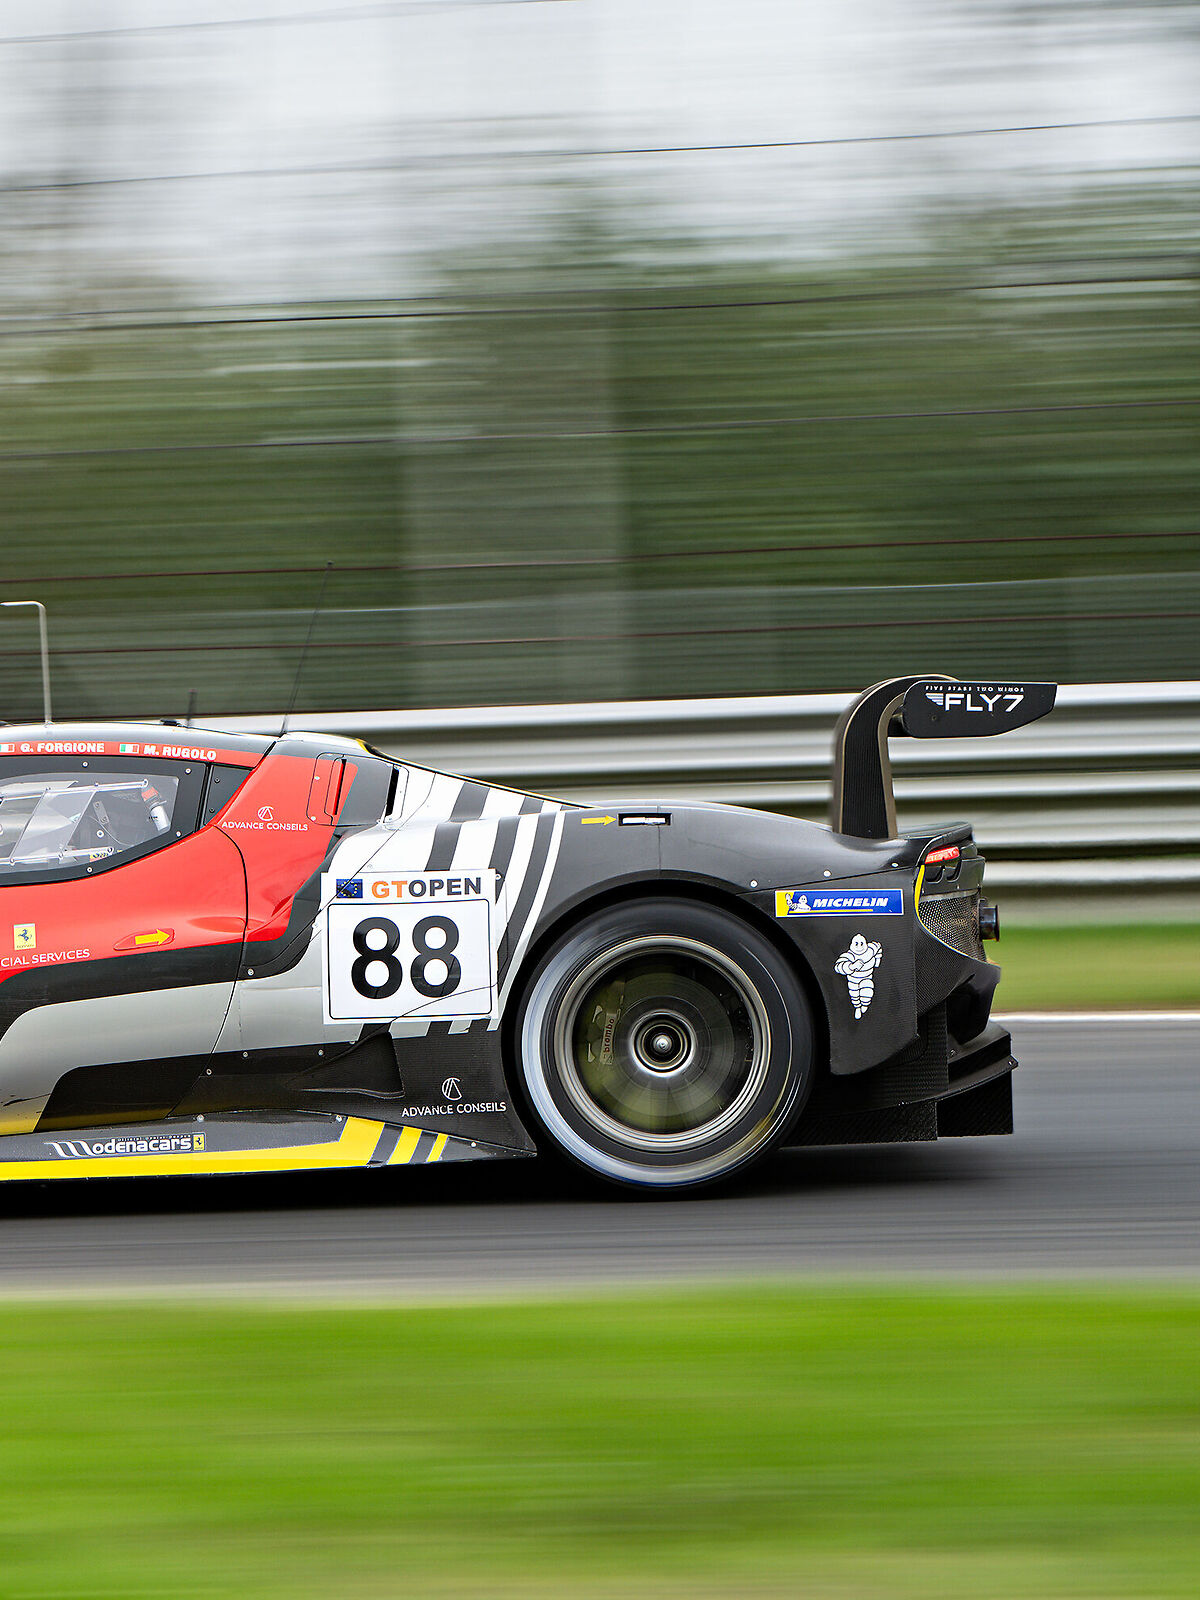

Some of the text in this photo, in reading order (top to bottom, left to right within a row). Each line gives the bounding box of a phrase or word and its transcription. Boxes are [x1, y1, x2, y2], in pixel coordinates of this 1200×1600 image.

[945, 693, 1024, 712] FLY7
[20, 743, 105, 753] G. FORGIONE
[143, 745, 217, 760] M. RUGOLO
[221, 821, 309, 831] ADVANCE CONSEILS
[812, 897, 889, 908] MICHELIN
[31, 948, 90, 964] SERVICES
[351, 915, 462, 999] 88
[401, 1101, 507, 1117] ADVANCE CONSEILS
